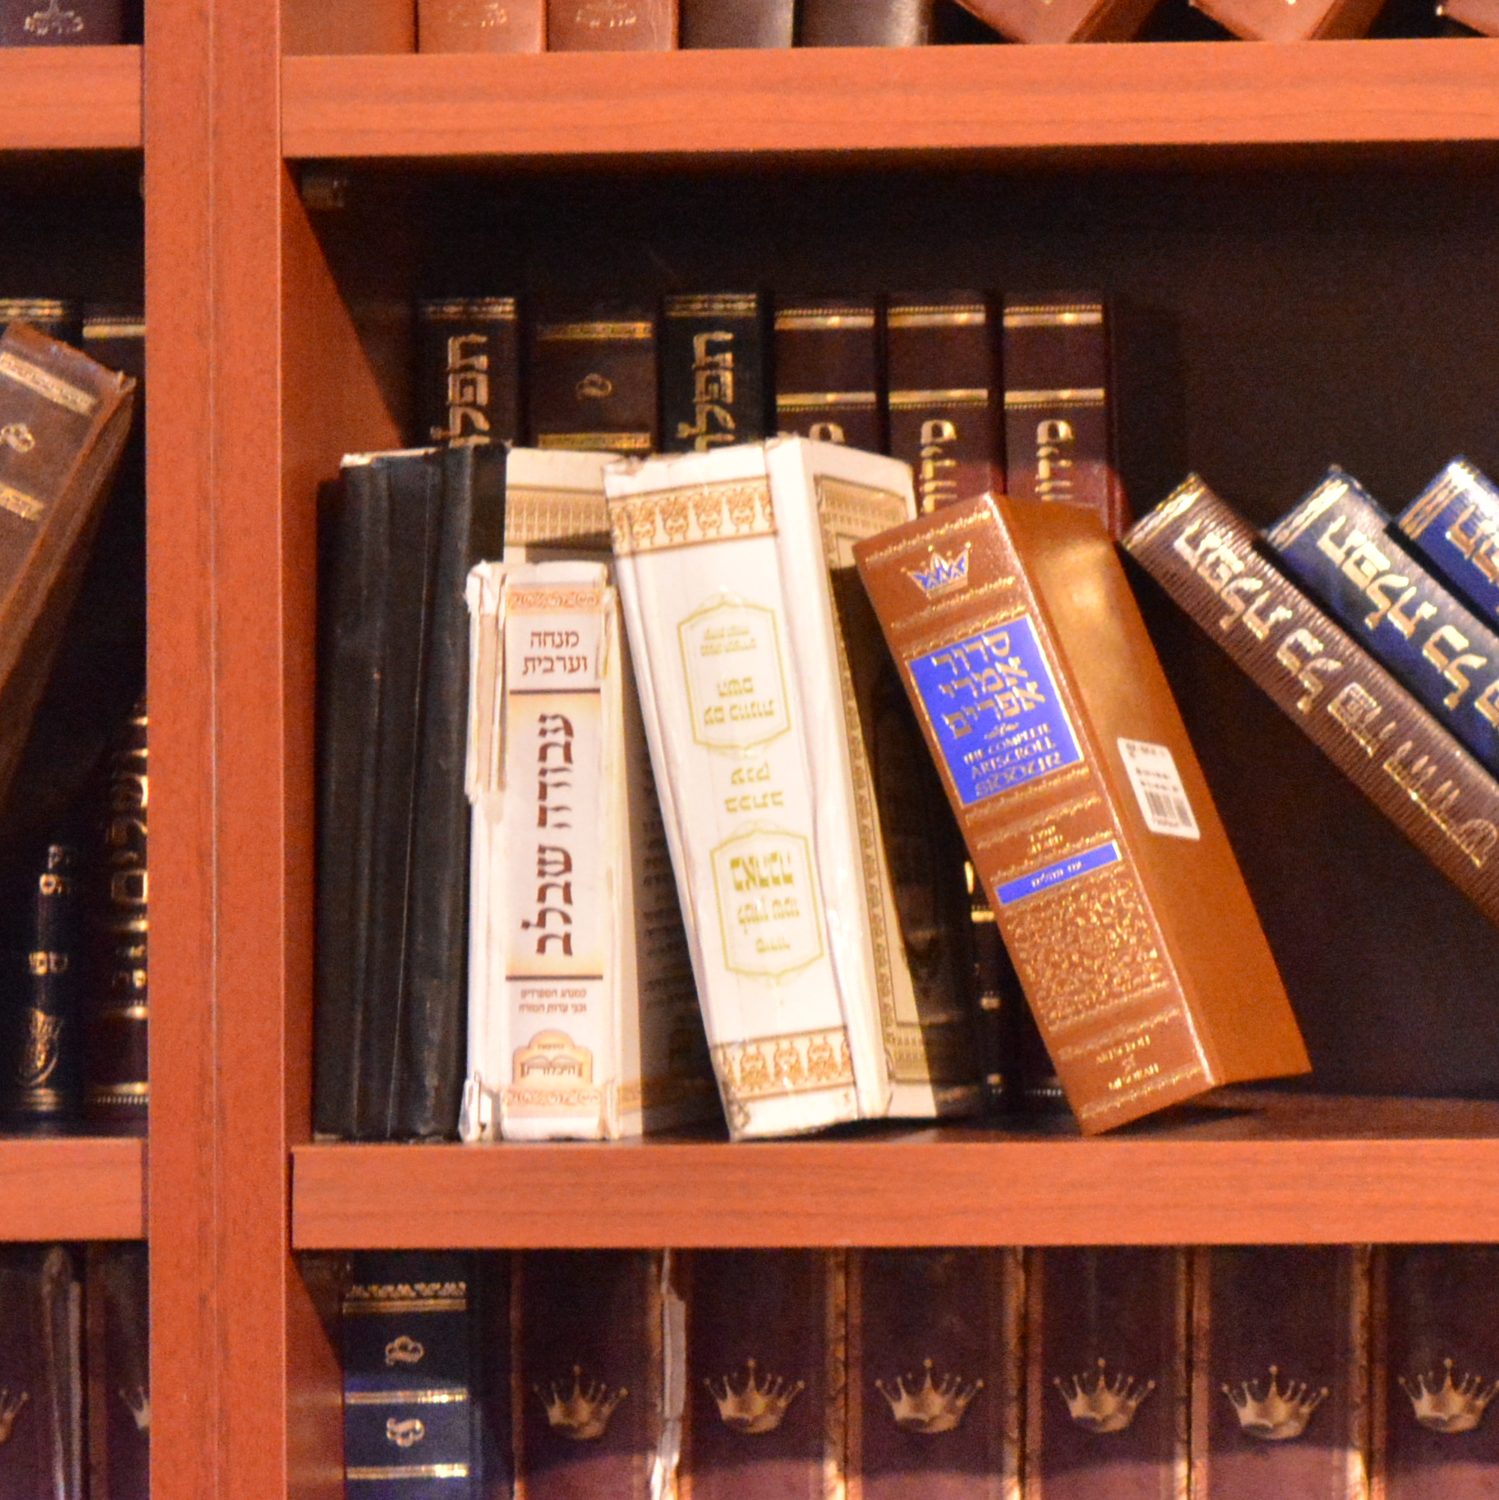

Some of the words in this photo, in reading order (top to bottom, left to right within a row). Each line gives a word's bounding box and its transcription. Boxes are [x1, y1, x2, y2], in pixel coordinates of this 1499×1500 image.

[1317, 515, 1437, 637] תפלת
[1424, 624, 1487, 710] כל
[529, 630, 580, 649] מנחה
[932, 631, 1010, 673] סדור
[522, 654, 588, 676] וערבית
[939, 656, 1029, 698] אמרי
[942, 680, 1046, 738] אפרים
[964, 748, 984, 765] THE
[988, 722, 1051, 754] COMPLETE
[972, 736, 1056, 780] ARTSCROLL
[537, 712, 575, 830] עבודה
[521, 843, 573, 959] שבלב
